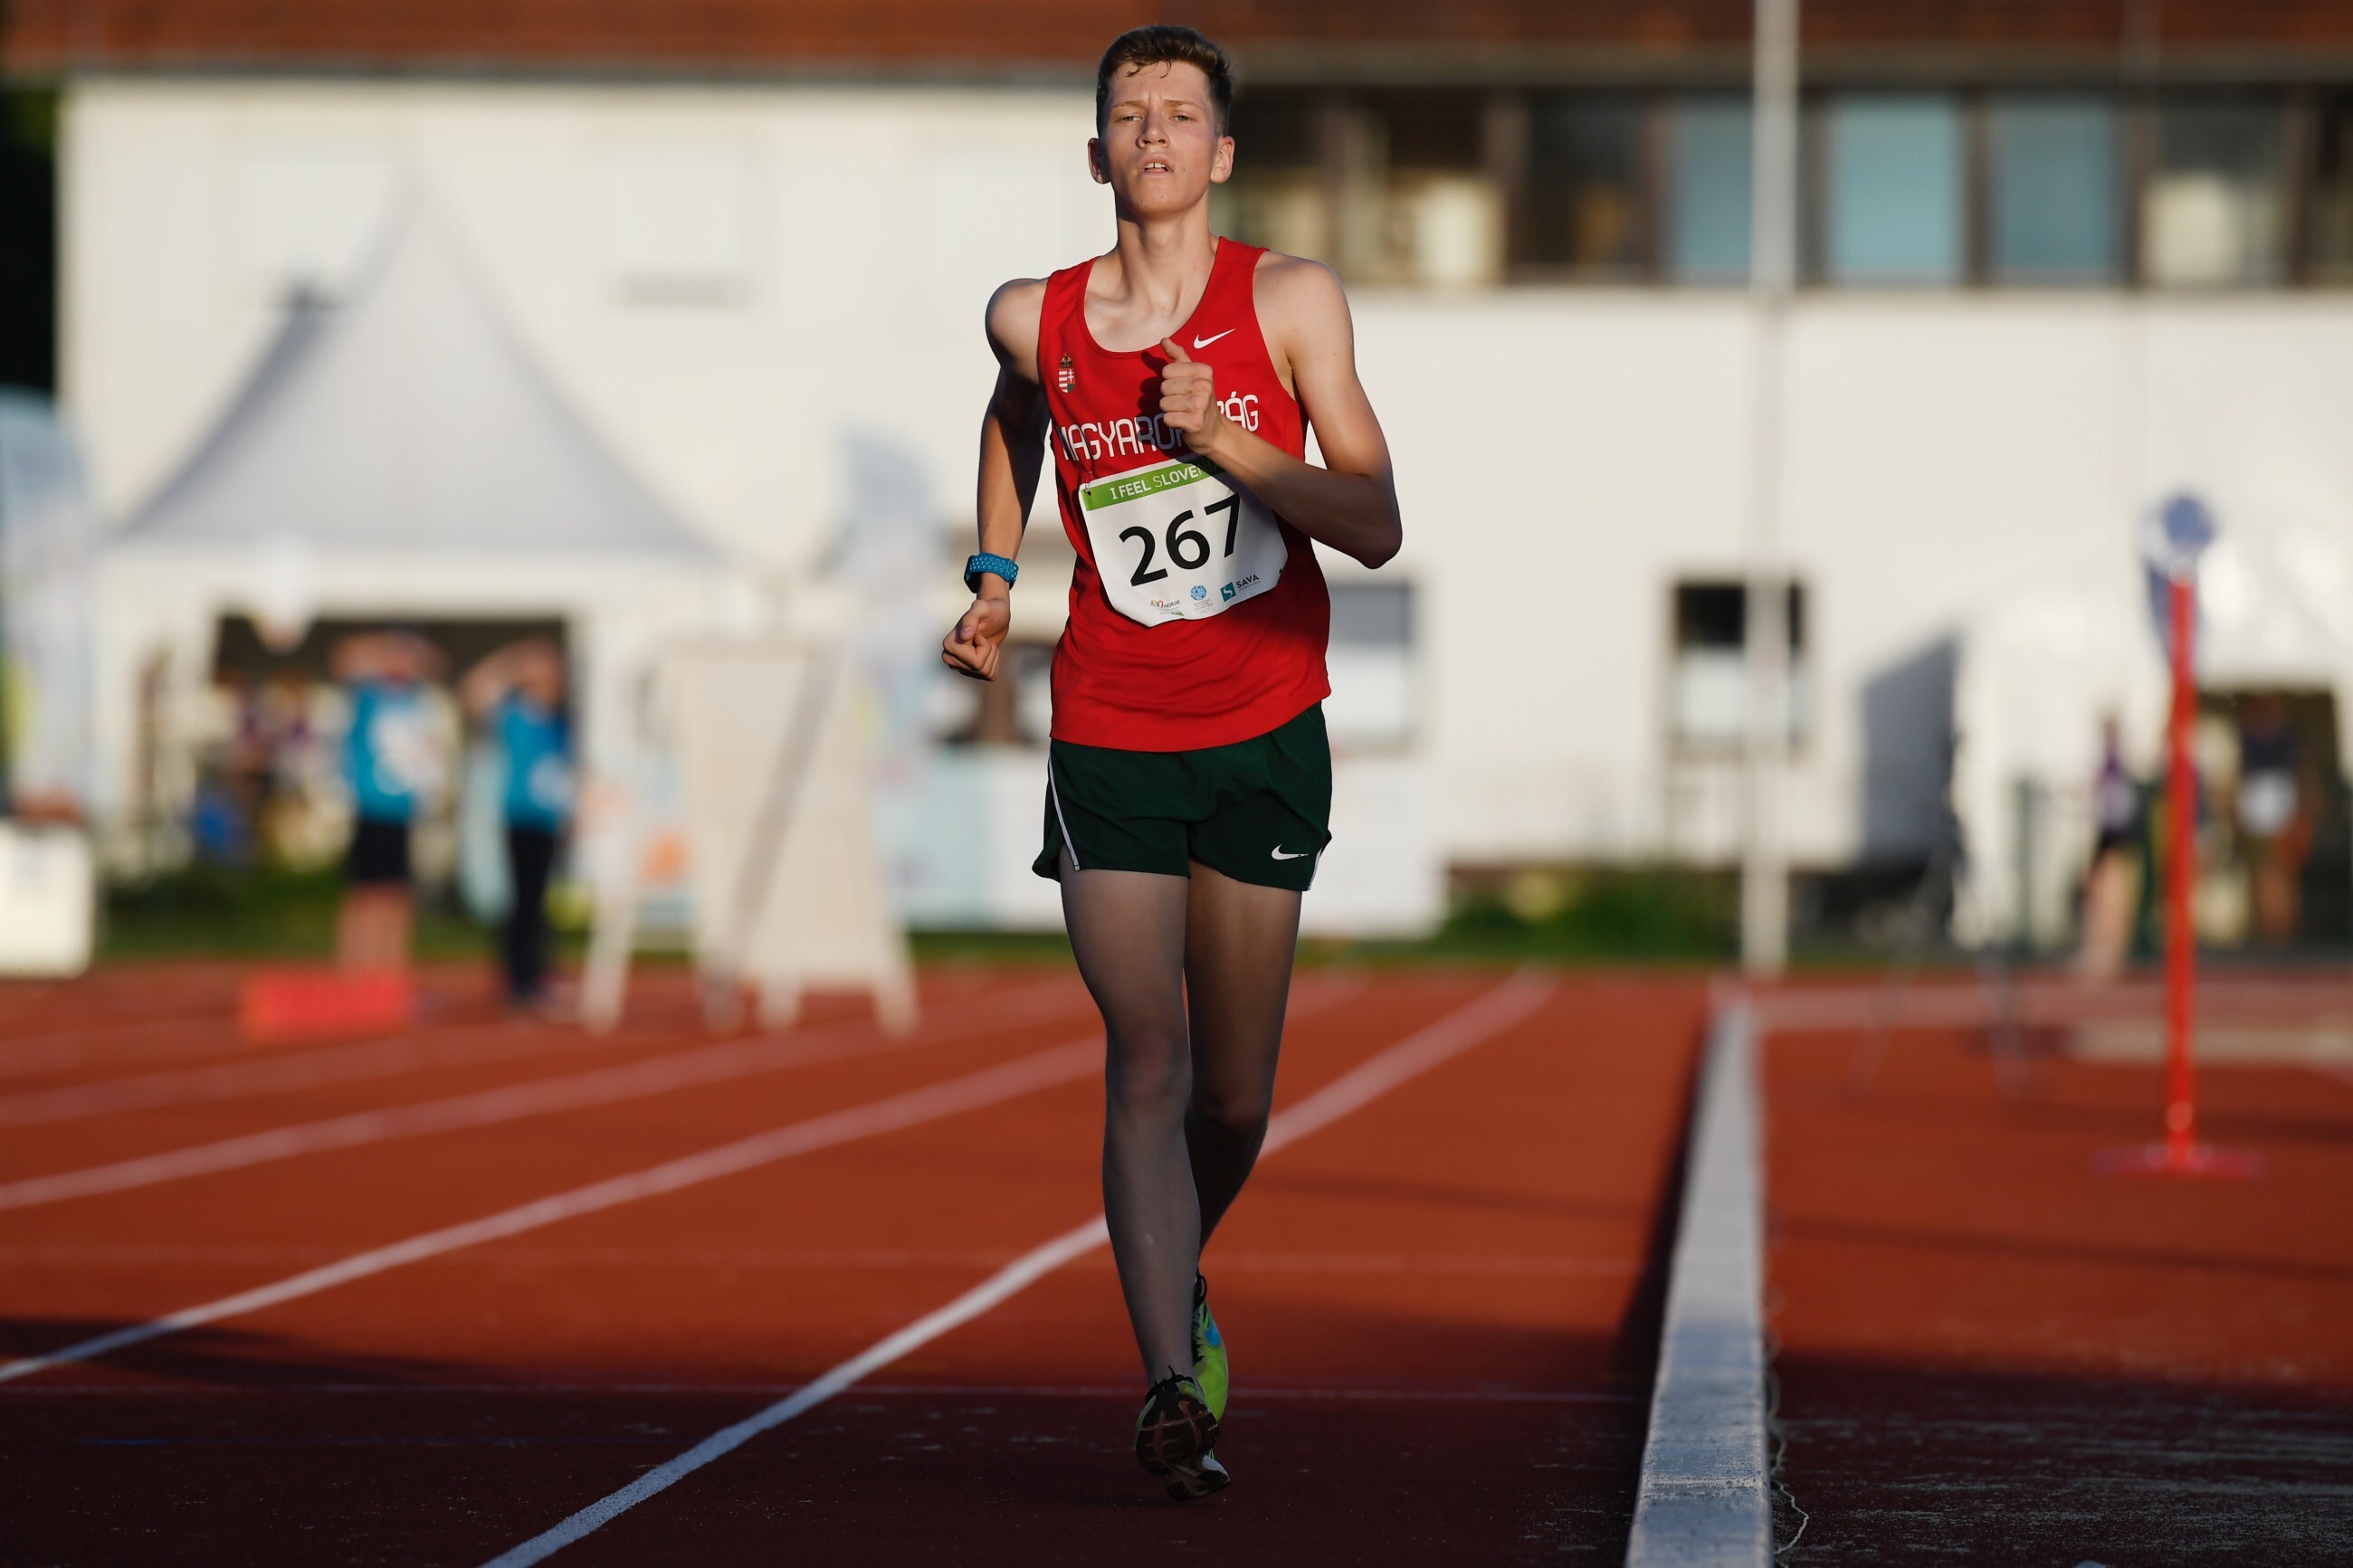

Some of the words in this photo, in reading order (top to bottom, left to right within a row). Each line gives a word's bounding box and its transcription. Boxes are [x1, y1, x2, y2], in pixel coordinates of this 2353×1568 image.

[1110, 487, 1119, 500] I
[1119, 480, 1152, 498] FEEL
[1119, 493, 1240, 587] 267
[1235, 574, 1260, 589] SAVA
